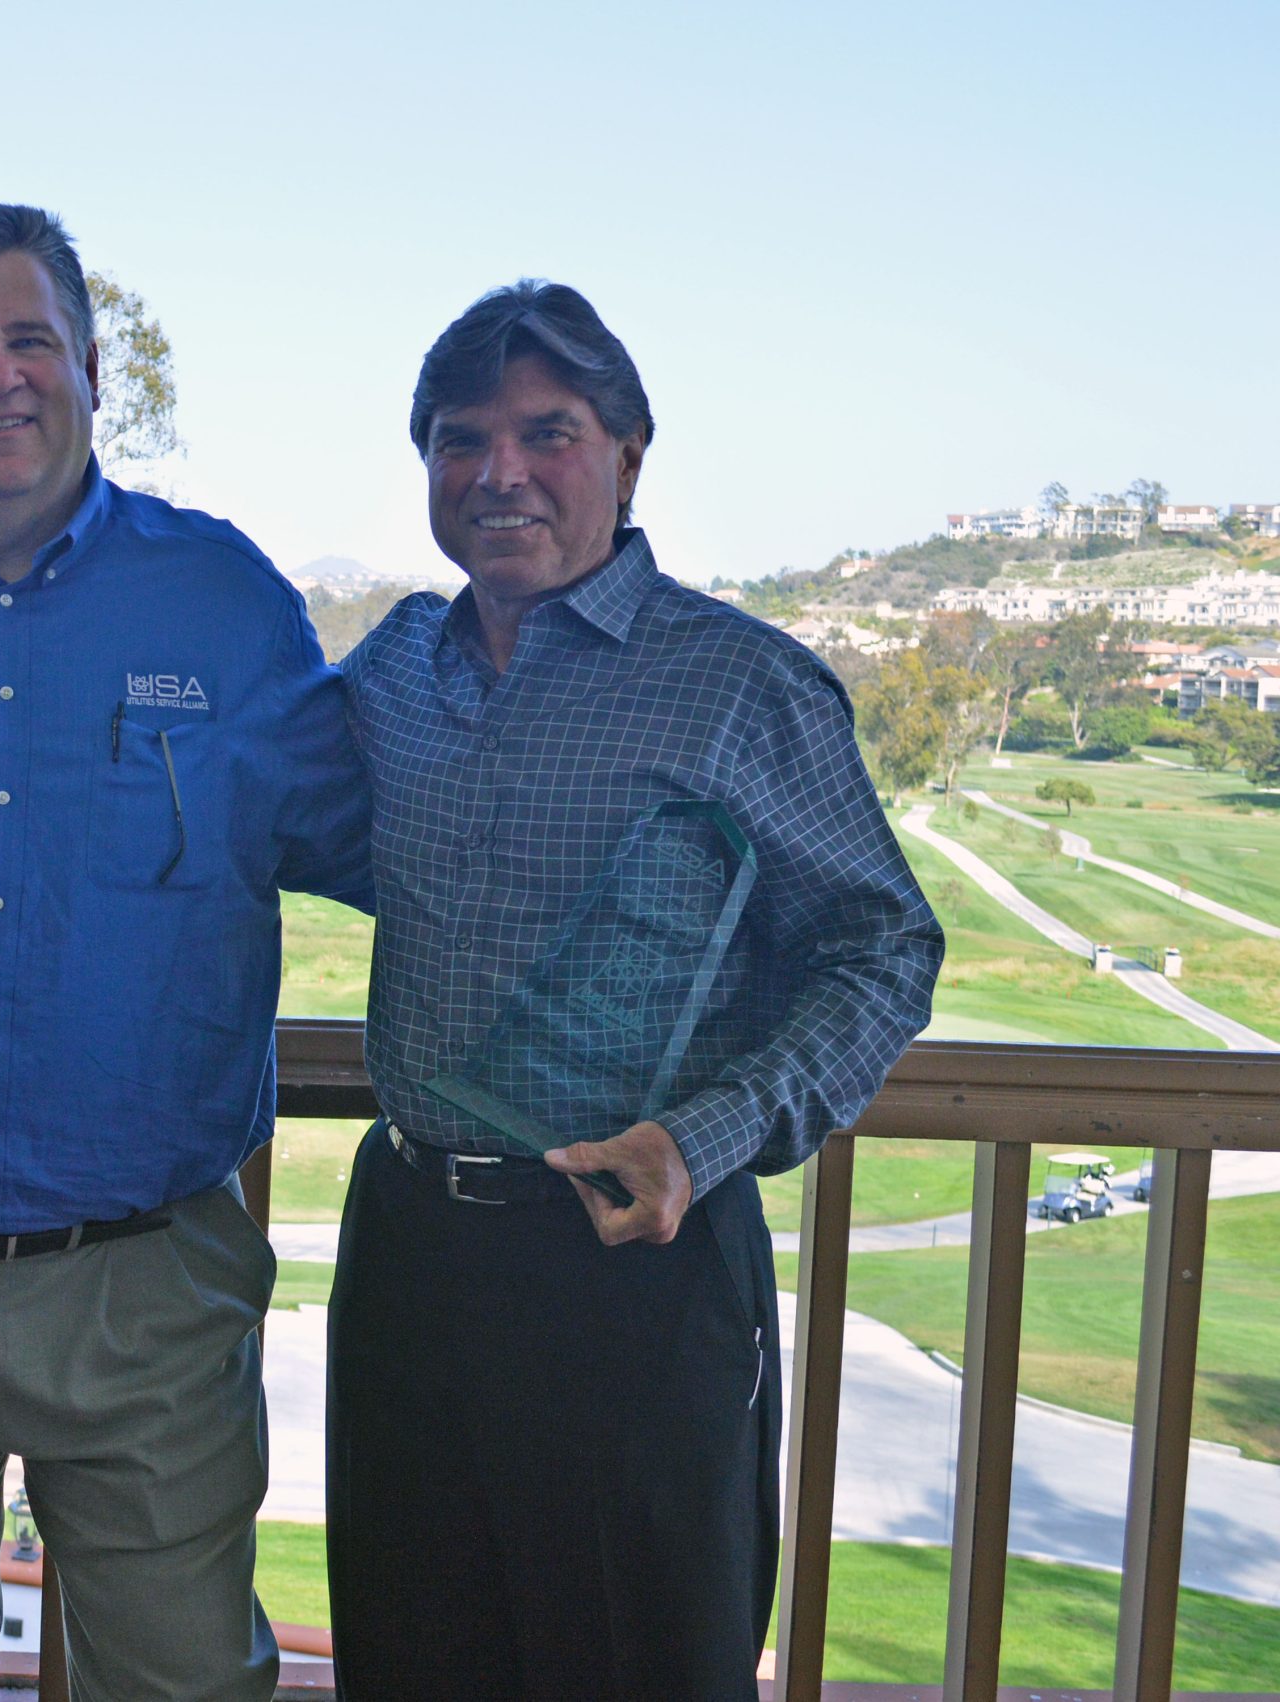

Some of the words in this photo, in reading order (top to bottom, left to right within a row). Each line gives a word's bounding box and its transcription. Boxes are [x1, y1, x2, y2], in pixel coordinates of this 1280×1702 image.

[127, 673, 207, 700] USA
[127, 697, 155, 706] UTILITIES
[156, 698, 181, 708] SERVICE
[182, 700, 210, 710] ALLIANCE
